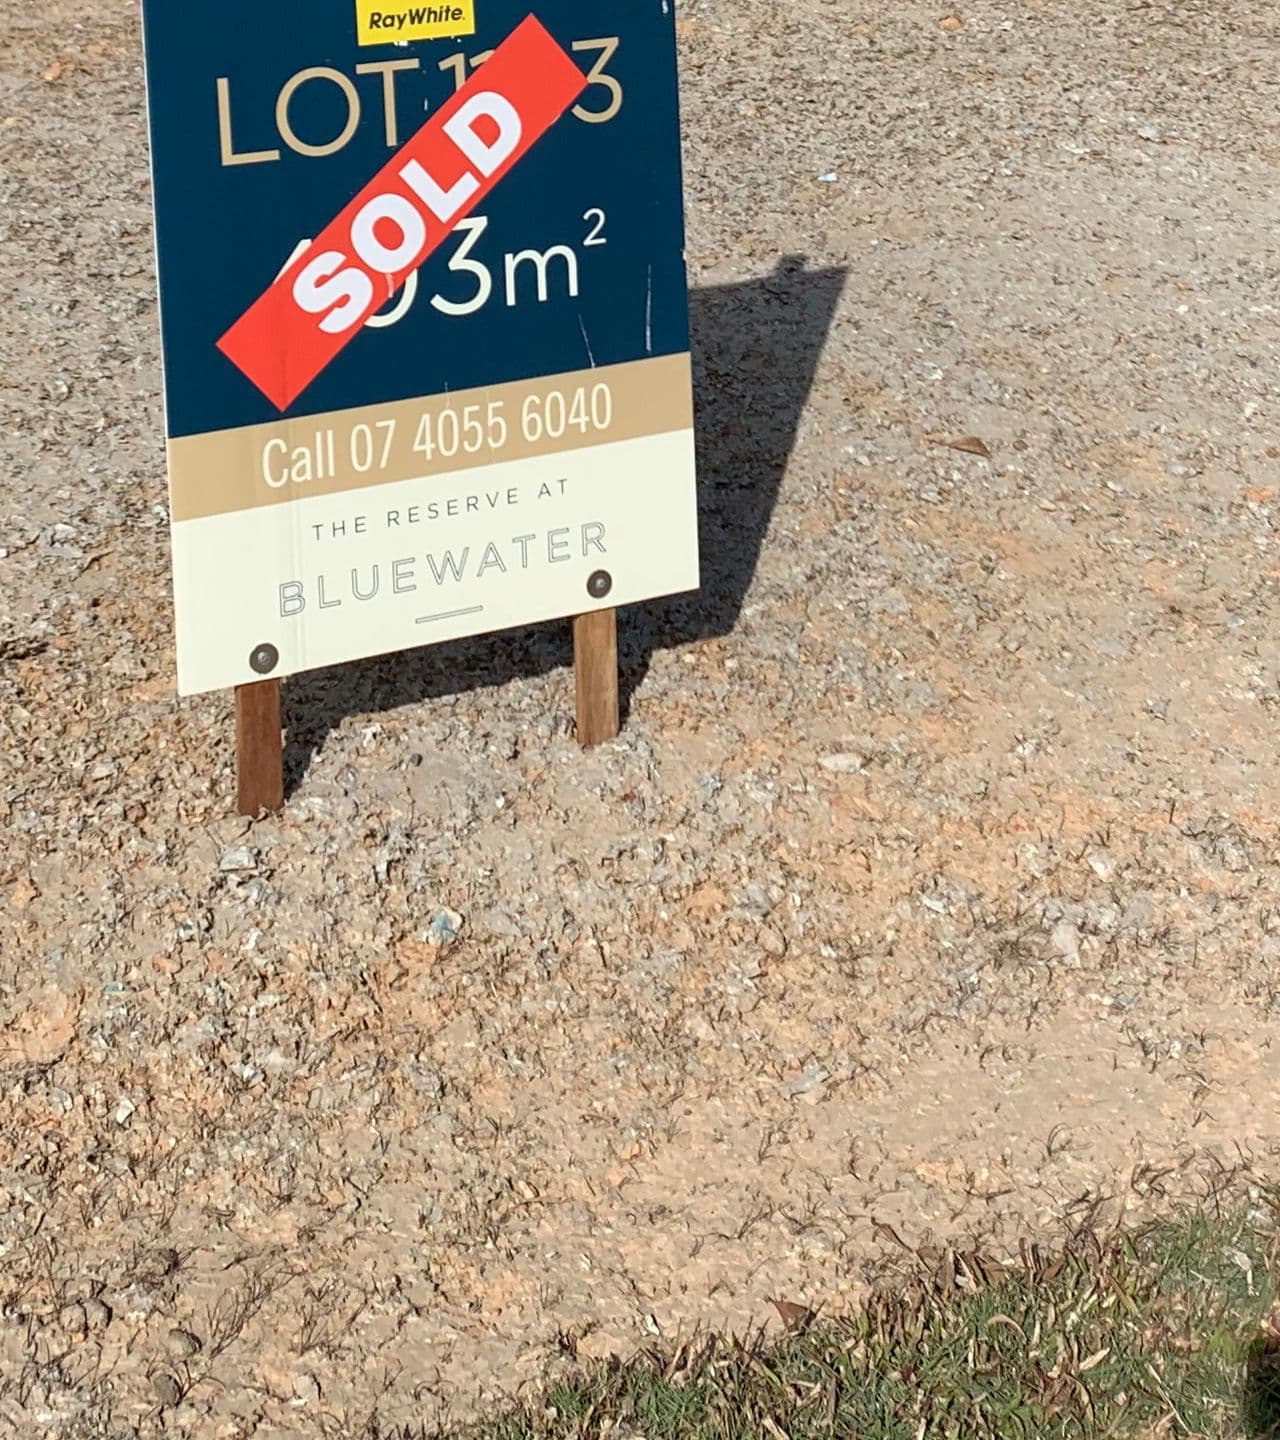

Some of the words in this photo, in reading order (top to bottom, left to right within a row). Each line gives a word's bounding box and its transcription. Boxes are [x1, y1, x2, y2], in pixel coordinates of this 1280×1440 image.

[216, 58, 420, 166] LOT
[292, 91, 522, 334] SOLD
[262, 429, 336, 488] Call
[350, 419, 397, 473] 07
[412, 400, 508, 461] 4055
[521, 382, 613, 443] 6040
[312, 516, 367, 541] THE
[387, 487, 519, 528] RESERVE
[537, 478, 569, 499] AT
[279, 521, 608, 618] BLUEWATER
